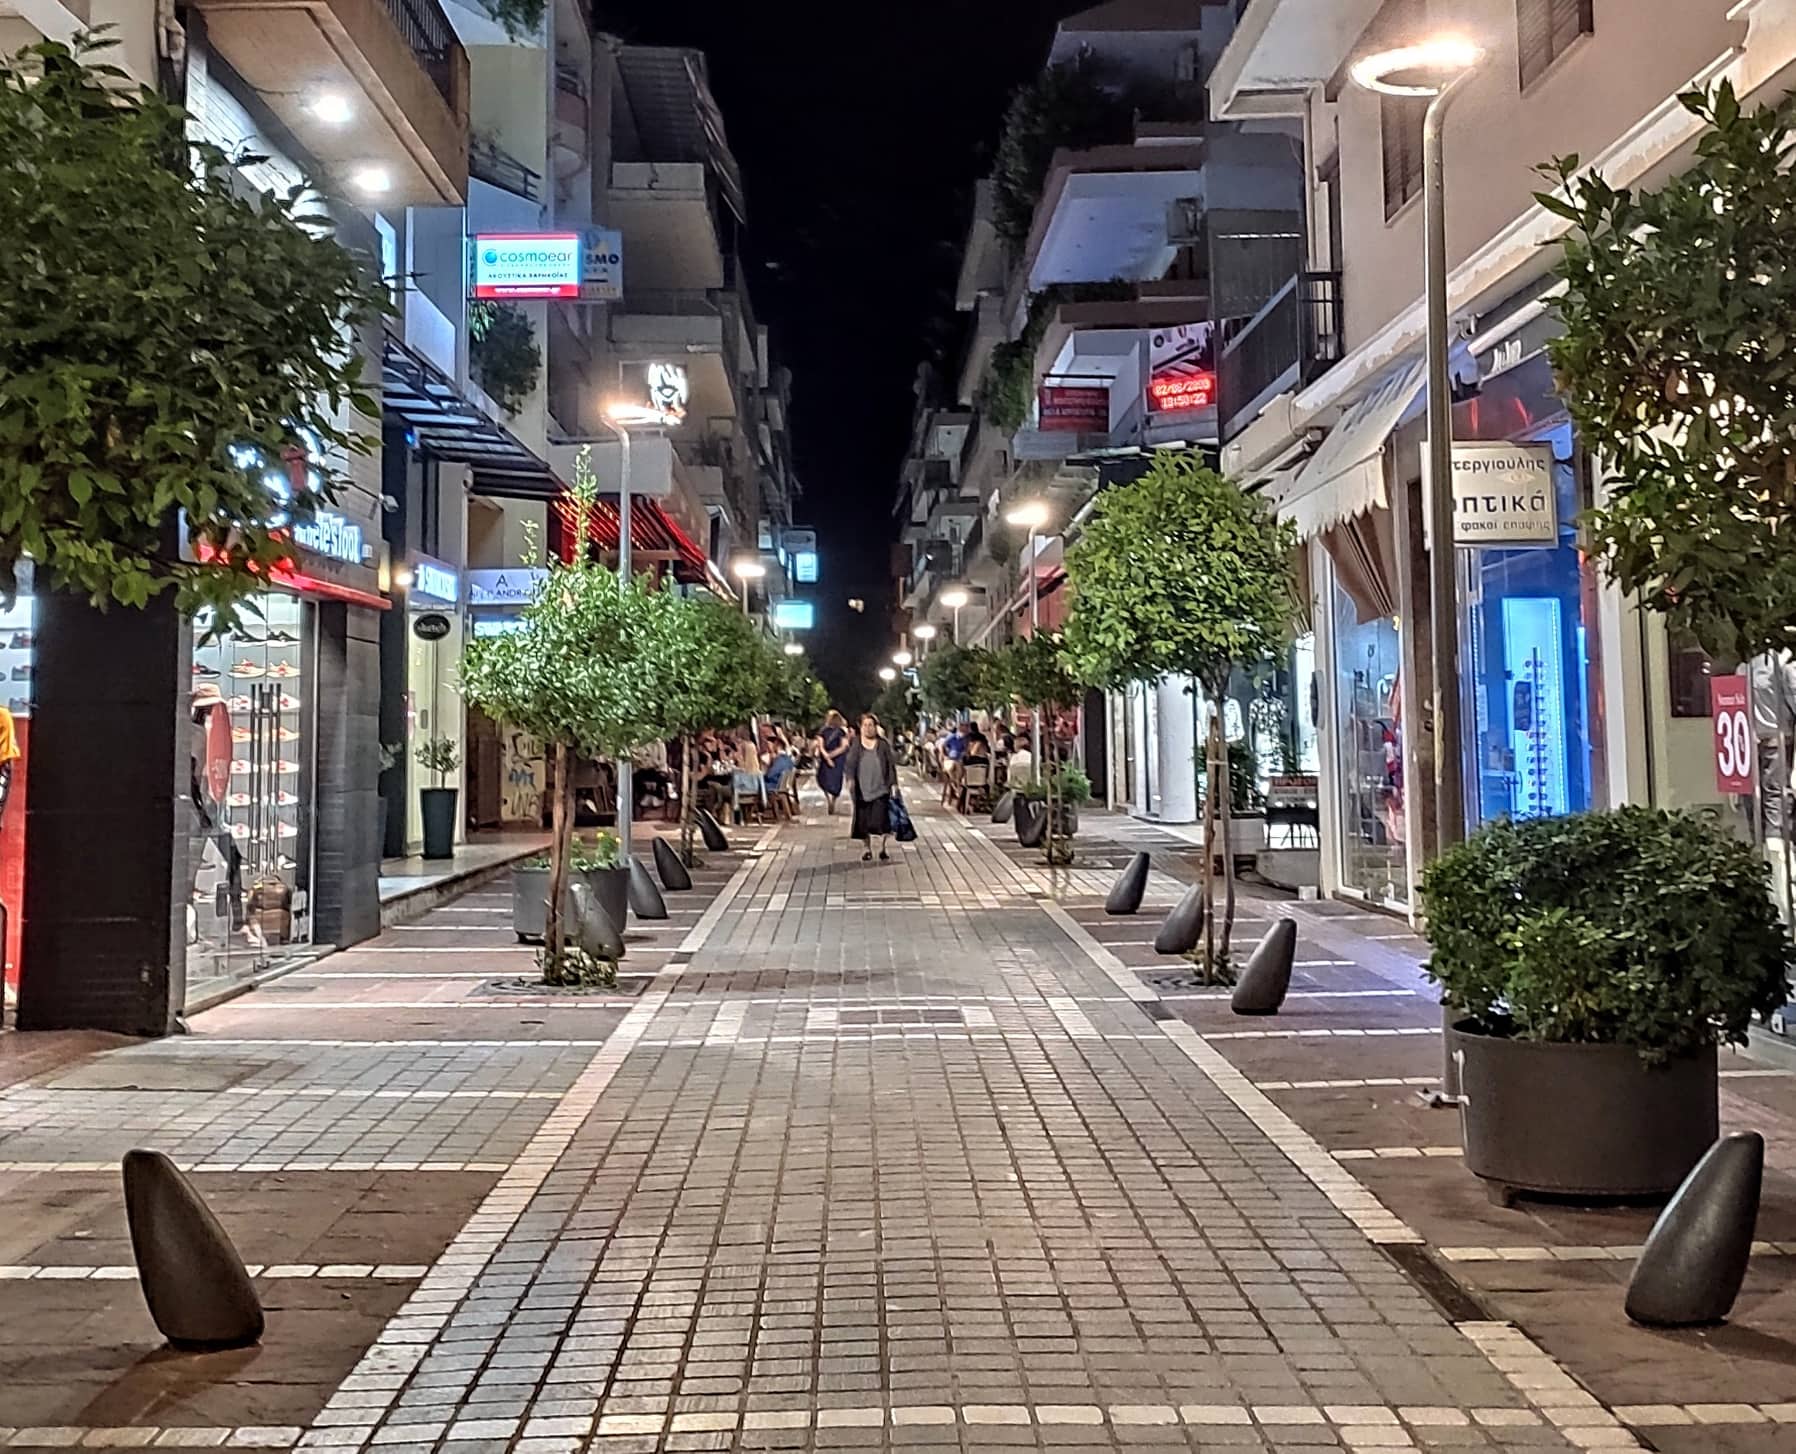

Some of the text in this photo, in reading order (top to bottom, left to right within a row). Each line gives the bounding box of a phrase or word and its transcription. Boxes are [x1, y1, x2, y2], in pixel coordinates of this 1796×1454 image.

[500, 252, 573, 263] cosmoear
[1453, 490, 1545, 513] πτικά
[1718, 711, 1750, 777] 30
